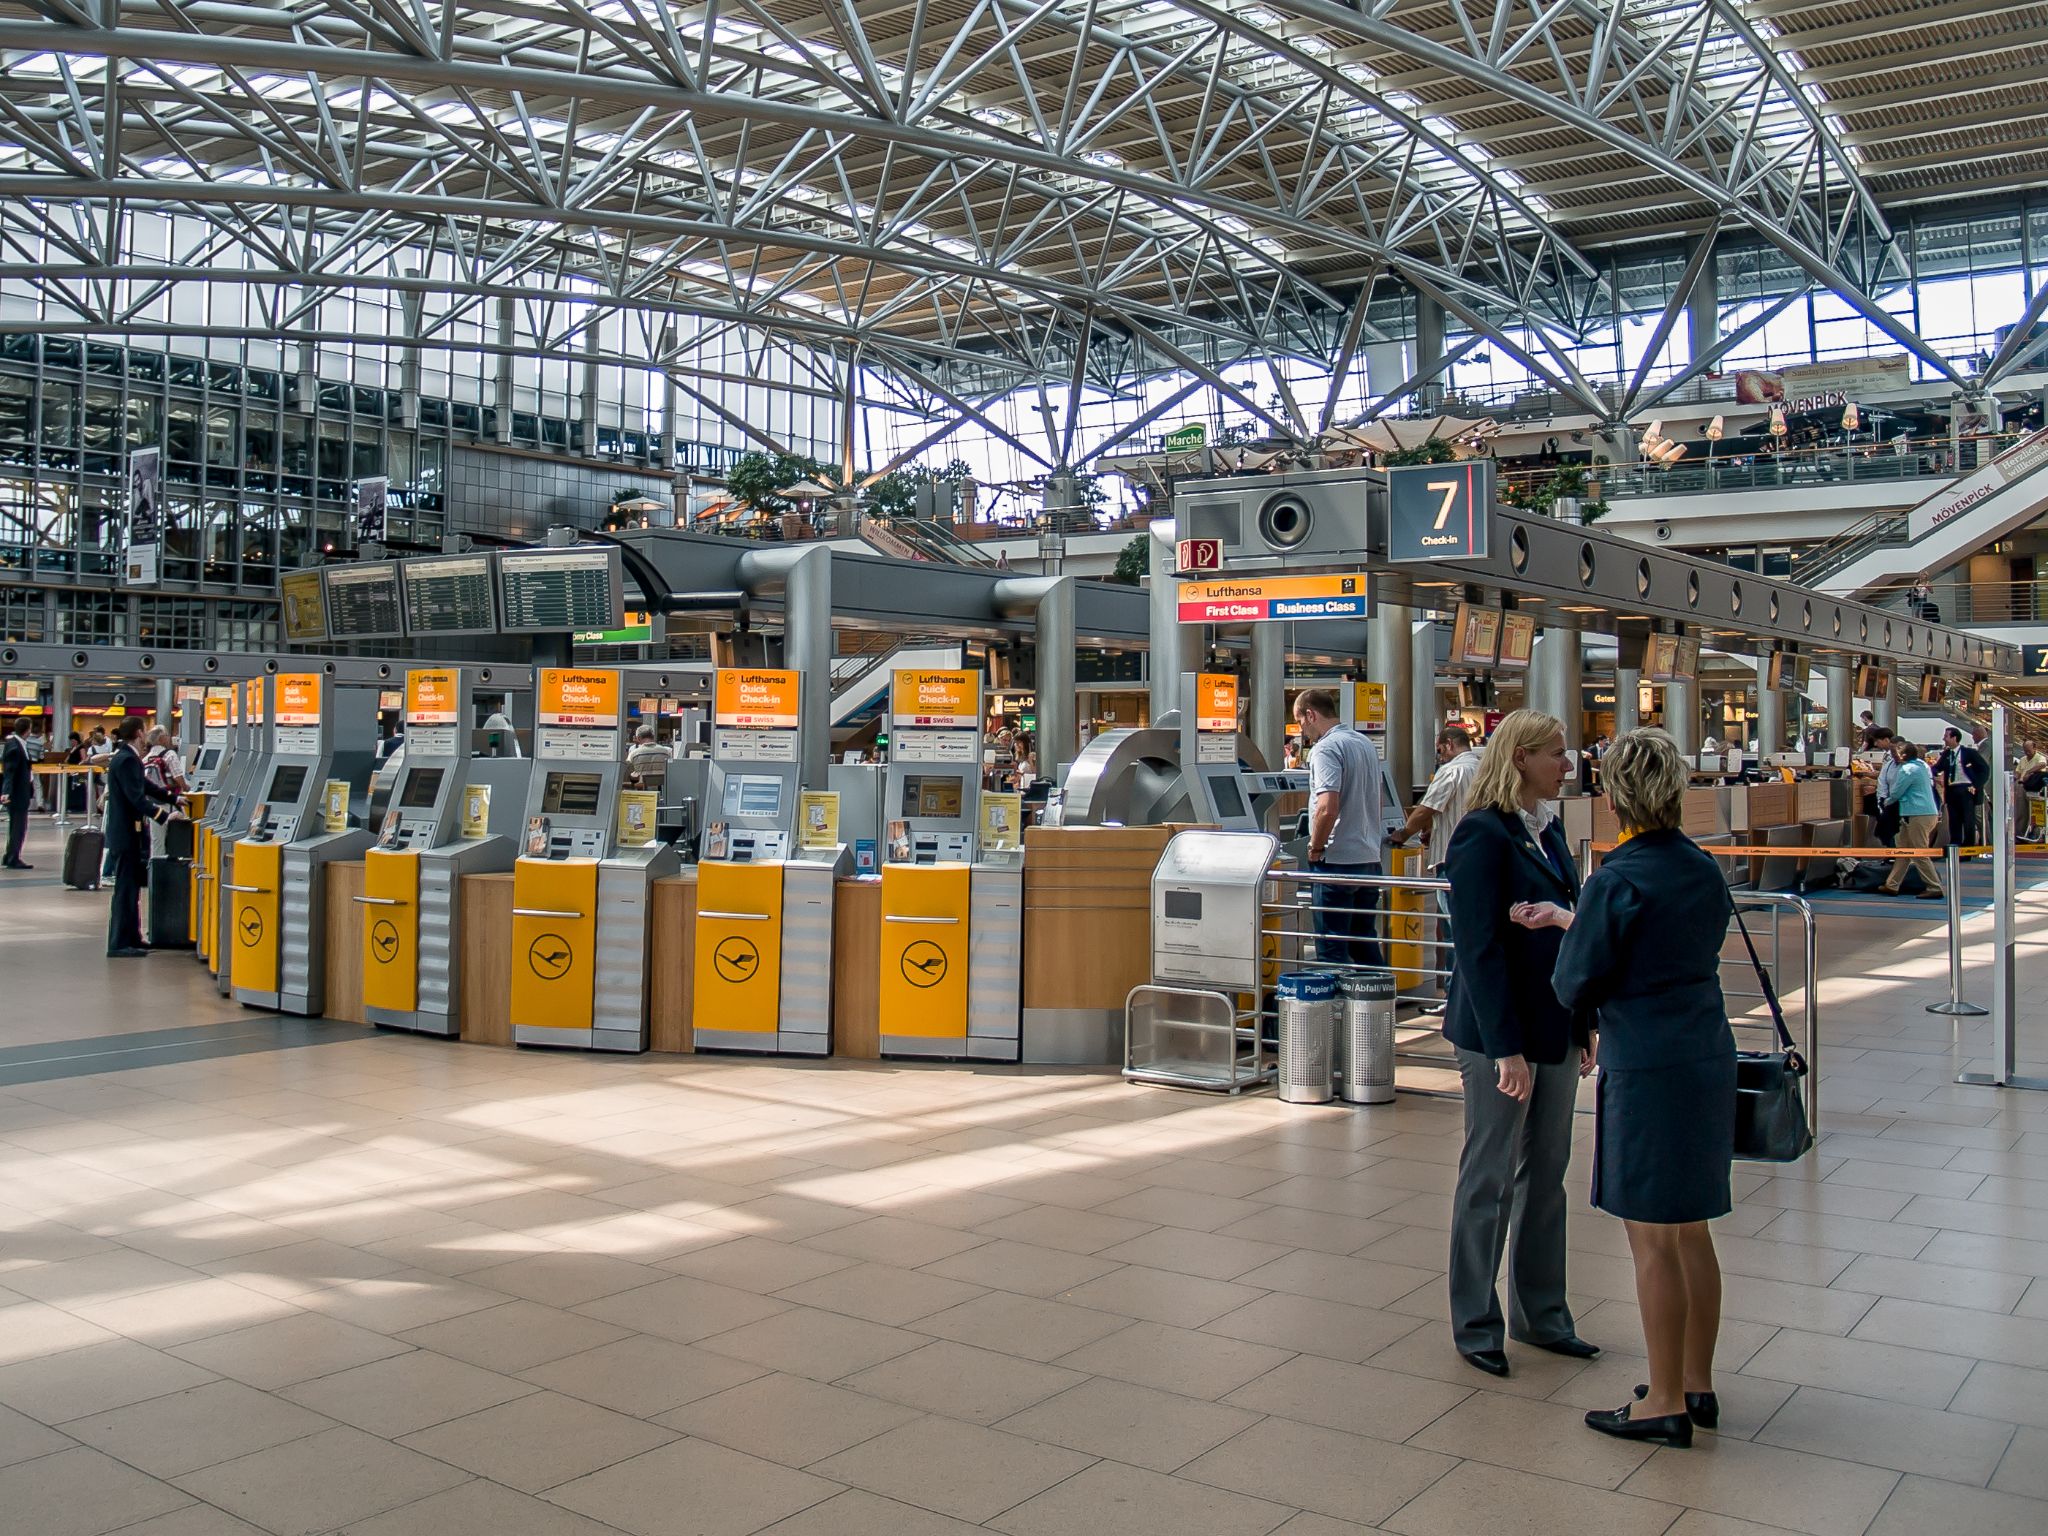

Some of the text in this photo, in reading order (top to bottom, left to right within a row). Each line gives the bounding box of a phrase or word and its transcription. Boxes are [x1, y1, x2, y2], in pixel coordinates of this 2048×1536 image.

[1792, 369, 1819, 377] Sunday
[1821, 364, 1850, 374] Brunch
[1767, 391, 1848, 418] MÖVENPICK
[1167, 433, 1203, 446] Marché
[2001, 444, 2040, 470] Herzlich
[1427, 480, 1459, 529] 7
[1931, 484, 1994, 525] MÖVENPICK
[870, 525, 910, 556] WILLKOMMEN
[1421, 535, 1458, 546] Check-in
[1206, 586, 1262, 598] Lufthansa
[1206, 605, 1259, 616] First Class
[1276, 601, 1356, 614] Business Class
[586, 632, 603, 640] Class
[563, 675, 606, 684] Lufthansa
[741, 675, 786, 684] Lufthansa
[919, 675, 965, 684] Lufthansa
[562, 684, 588, 693] Quick
[740, 684, 767, 693] Quick
[918, 684, 946, 693] Quick
[561, 694, 600, 703] Check-in
[740, 694, 780, 704] Check-in
[918, 694, 960, 703] Check-in
[1304, 985, 1329, 995] Papier
